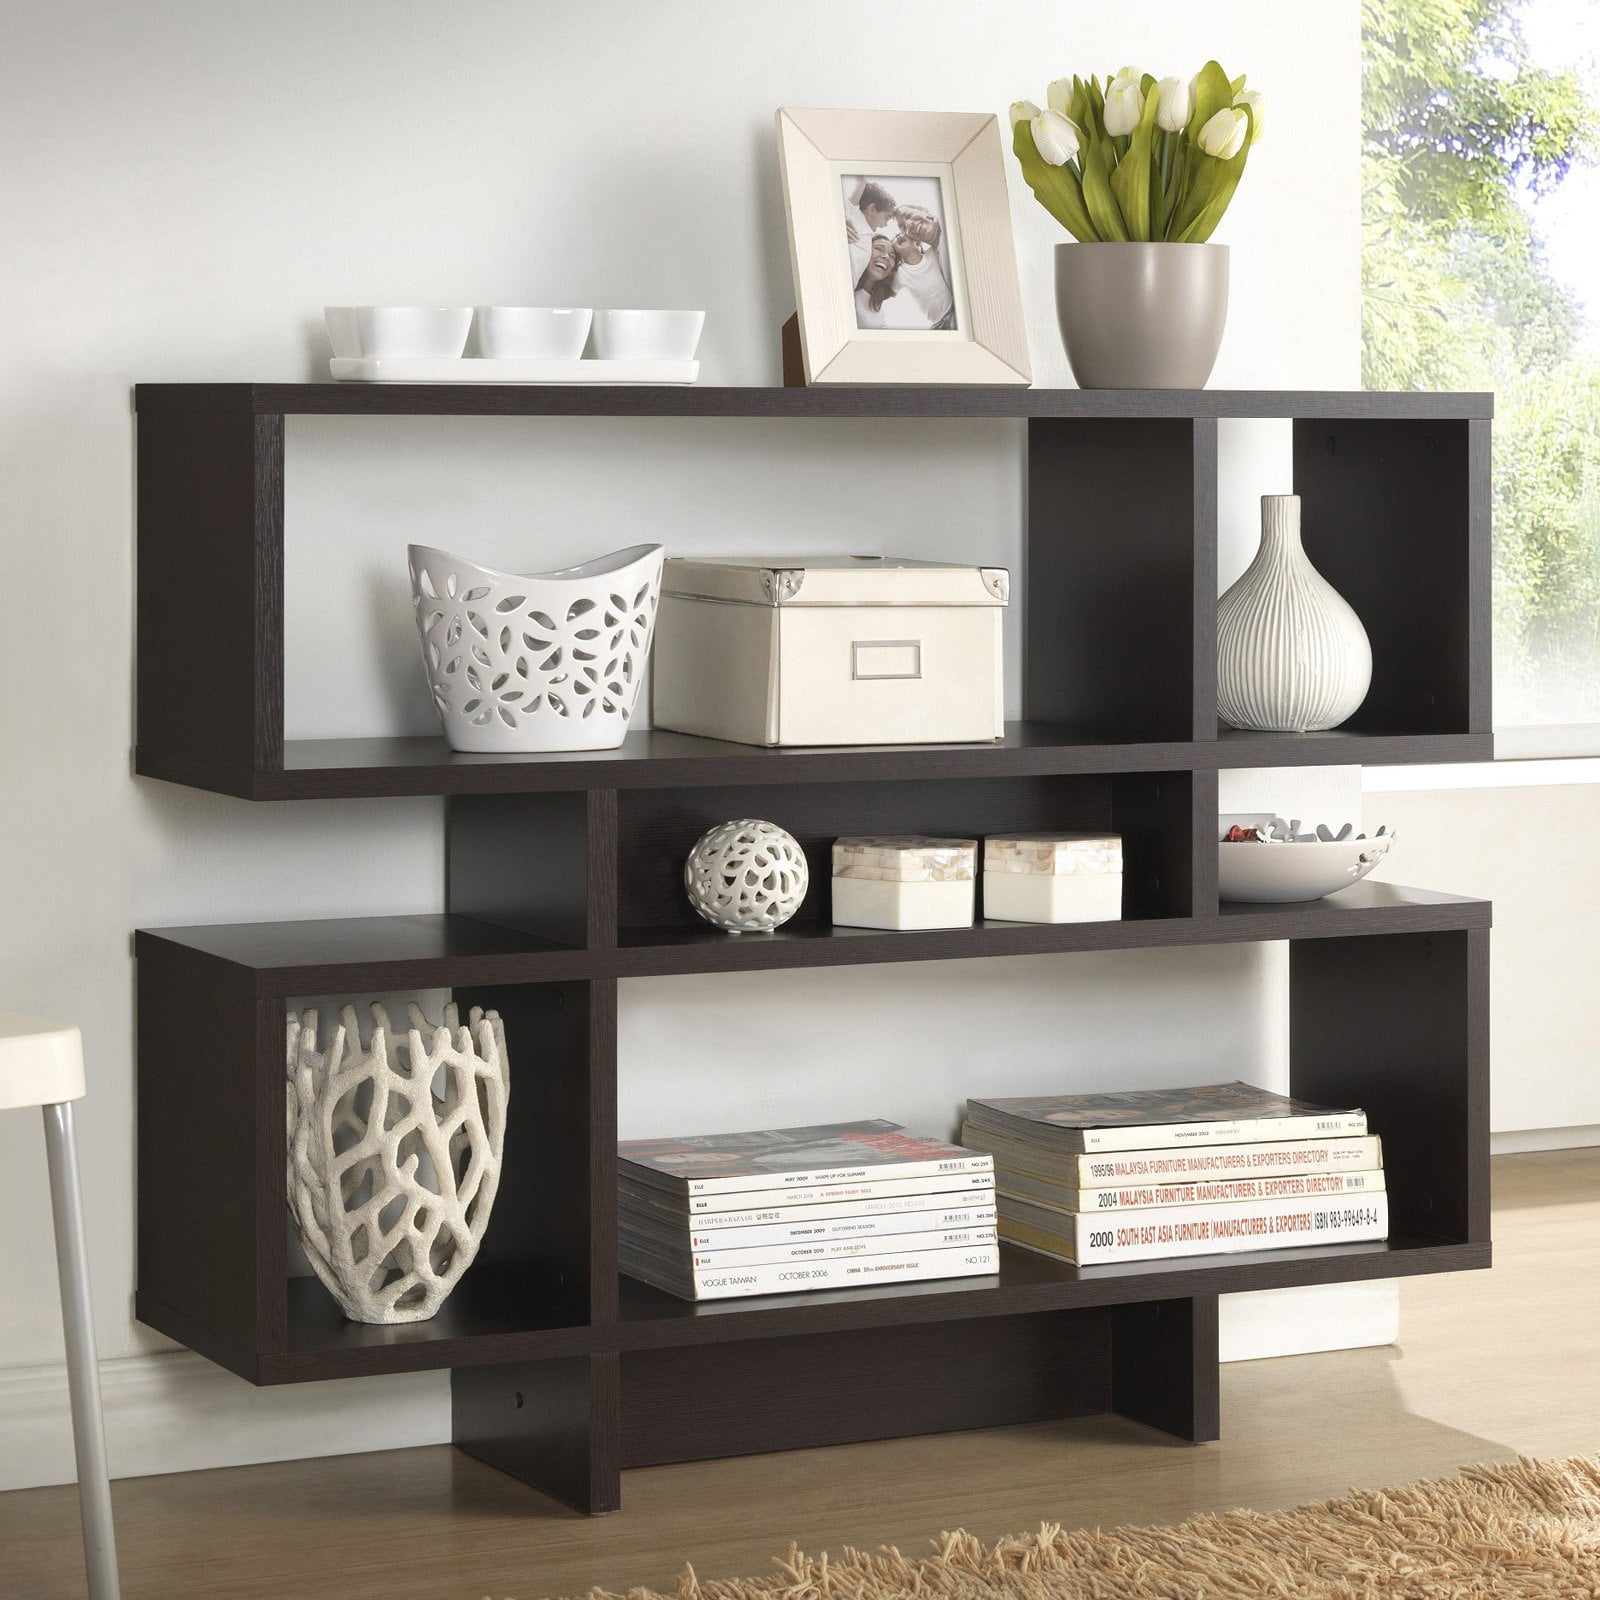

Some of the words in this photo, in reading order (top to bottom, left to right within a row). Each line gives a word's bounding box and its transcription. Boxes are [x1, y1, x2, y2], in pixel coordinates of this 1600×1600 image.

[1090, 1164, 1115, 1178] 1995/96
[1115, 1161, 1149, 1176] MALAYSIA
[1150, 1158, 1187, 1173] FURNITURE
[1187, 1155, 1245, 1171] MANUFACTURERS
[1246, 1154, 1251, 1167] &
[1252, 1152, 1292, 1167] EXPORTERS
[1292, 1149, 1329, 1164] DIRECTORY
[1098, 1192, 1118, 1208] 2004
[1119, 1190, 1154, 1206] MALAYSIA
[1155, 1186, 1195, 1204] FURNITURE
[1196, 1182, 1256, 1201] MANUFACTURERS
[1258, 1181, 1262, 1196] &
[1265, 1179, 1304, 1196] EXPORTERS
[1306, 1177, 1344, 1193] DIRECTORY
[1089, 1231, 1114, 1248] 2000
[1117, 1227, 1139, 1247] SOUTH
[1141, 1226, 1156, 1245] EAST
[1157, 1224, 1174, 1243] ASIA
[1174, 1221, 1209, 1242] FURNITURE
[1268, 1216, 1274, 1234] &
[1314, 1211, 1328, 1230] ISBN
[1330, 1208, 1378, 1229] 983-99649-8-4
[701, 1278, 728, 1287] VOGUE
[729, 1276, 757, 1286] TAIWAN
[778, 1271, 810, 1281] OCTOBER
[812, 1270, 829, 1278] 2006
[874, 1264, 905, 1272] ANNIVERSARY
